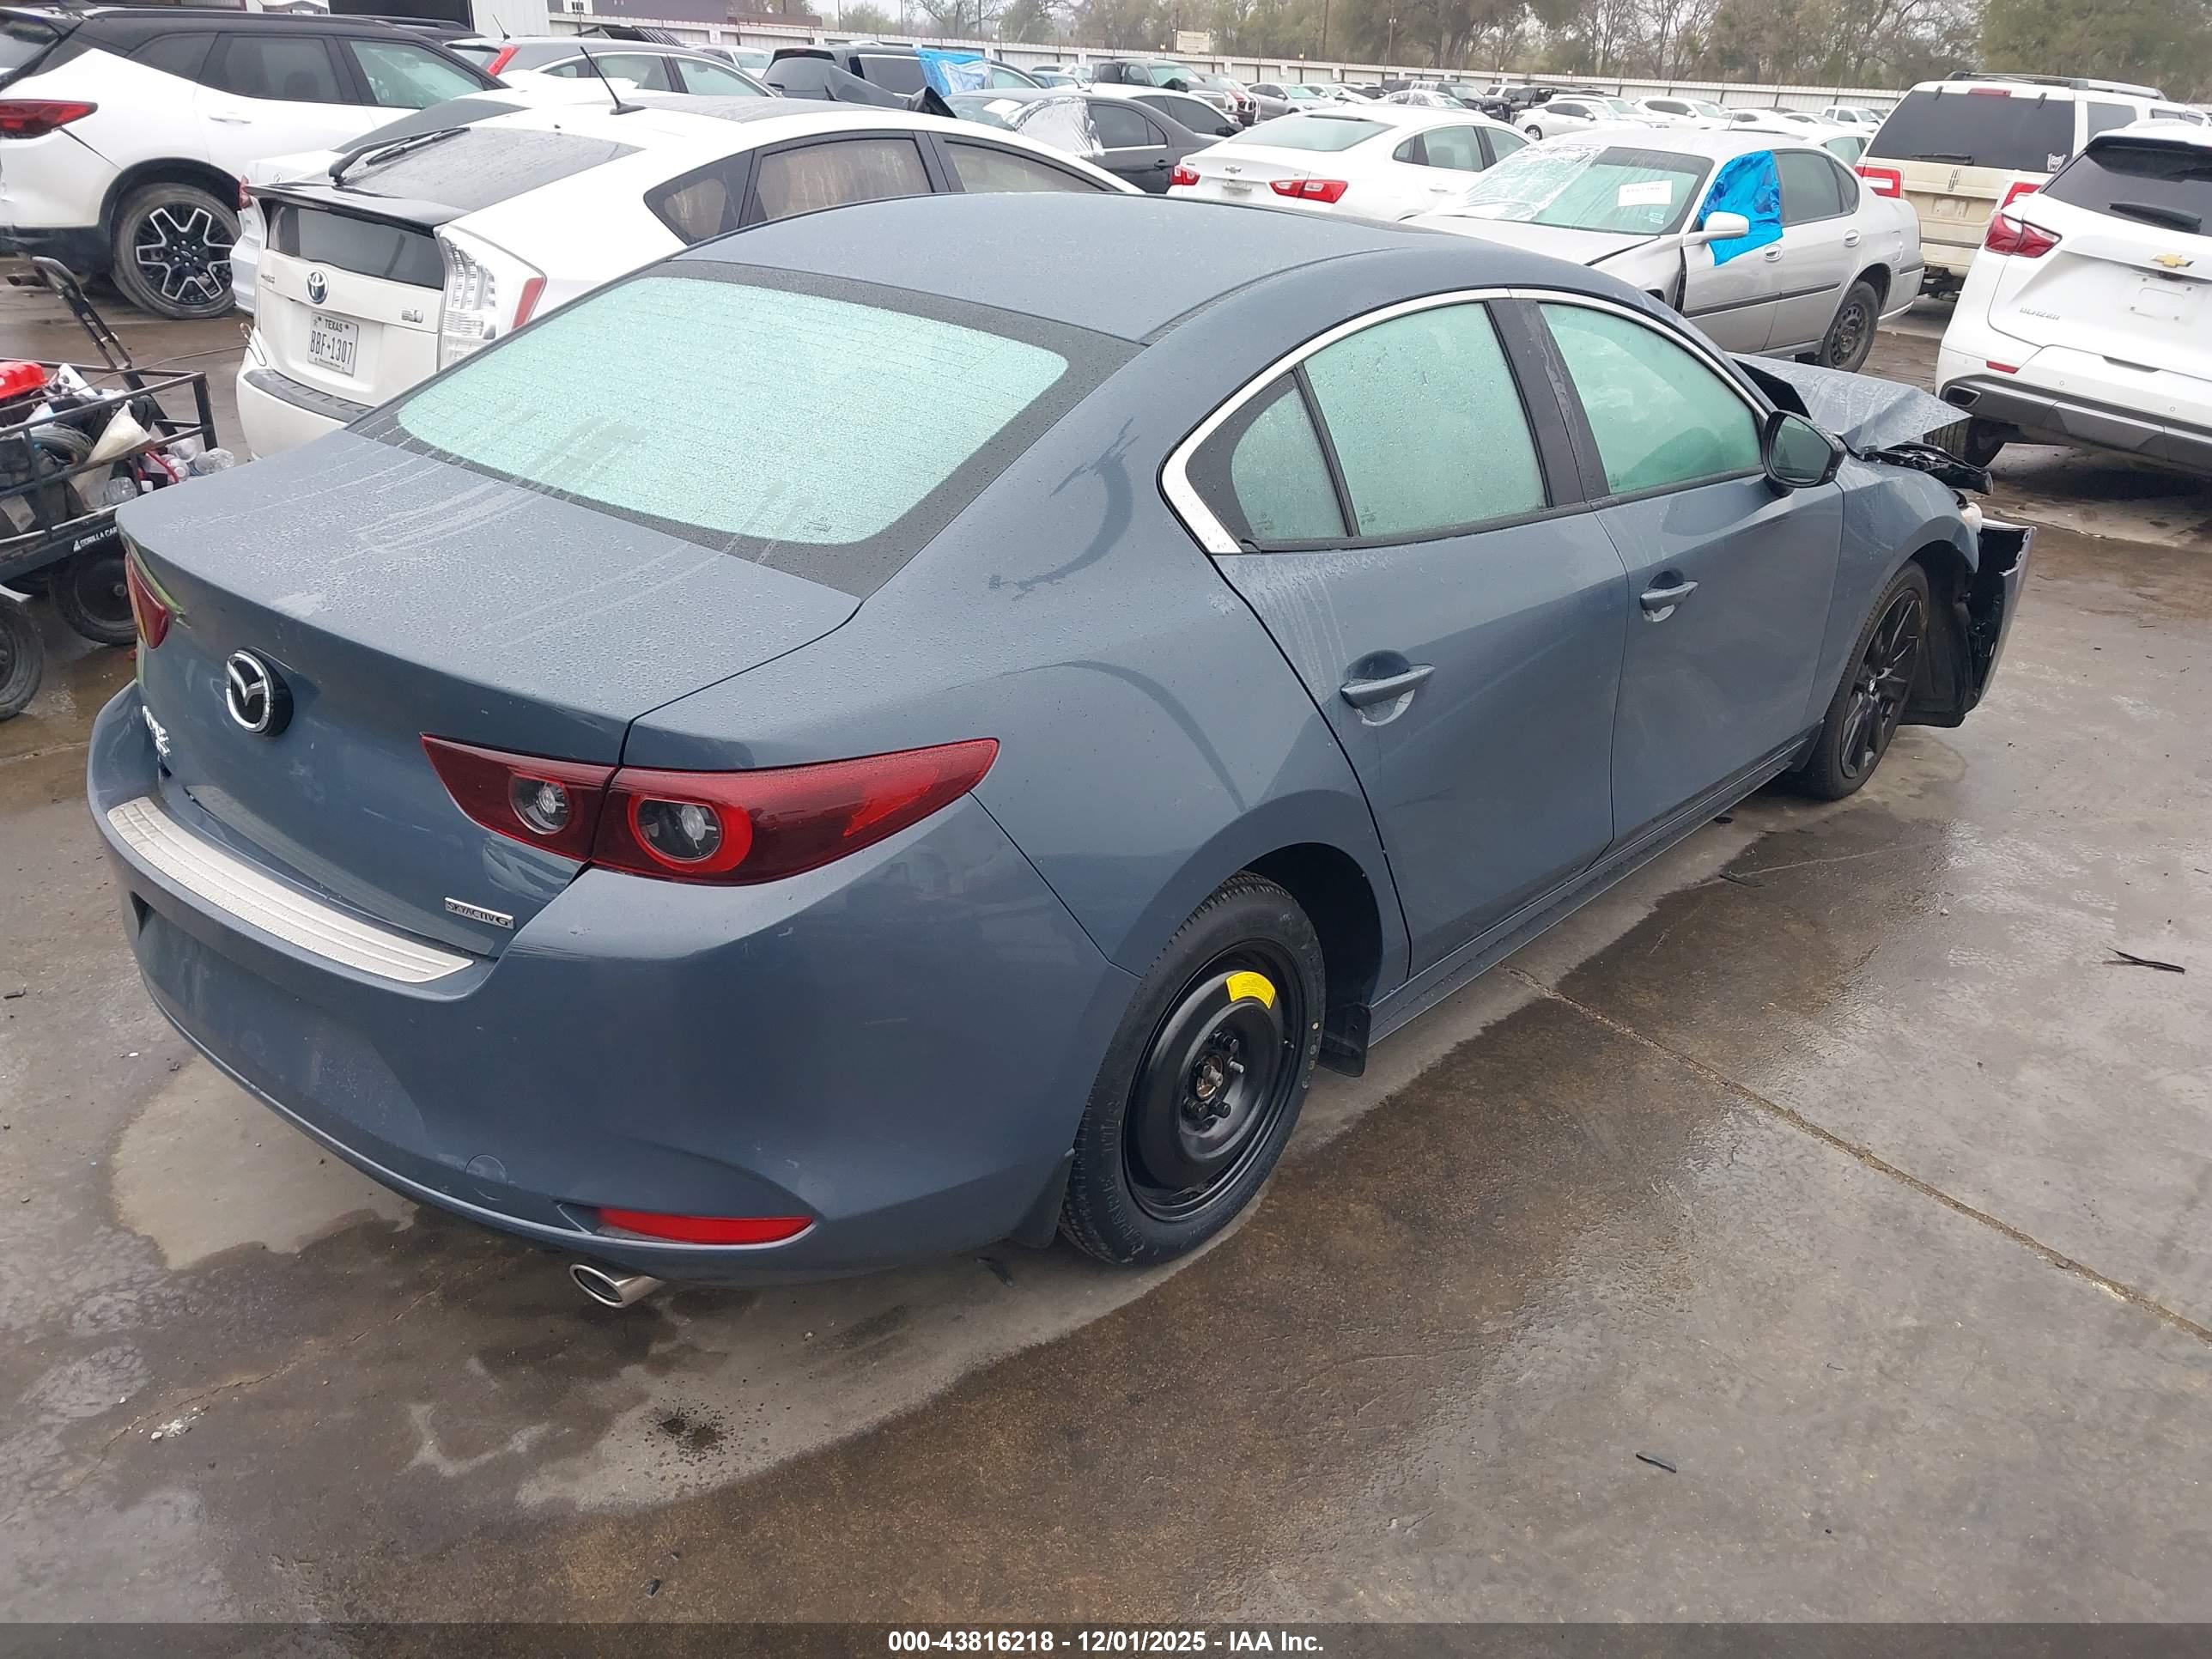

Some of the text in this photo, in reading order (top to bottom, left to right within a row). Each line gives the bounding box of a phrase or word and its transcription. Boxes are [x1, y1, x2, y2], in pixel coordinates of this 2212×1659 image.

[2019, 306, 2062, 320] BLAZER
[325, 318, 343, 333] TEXAS
[80, 532, 104, 547] GORILLA
